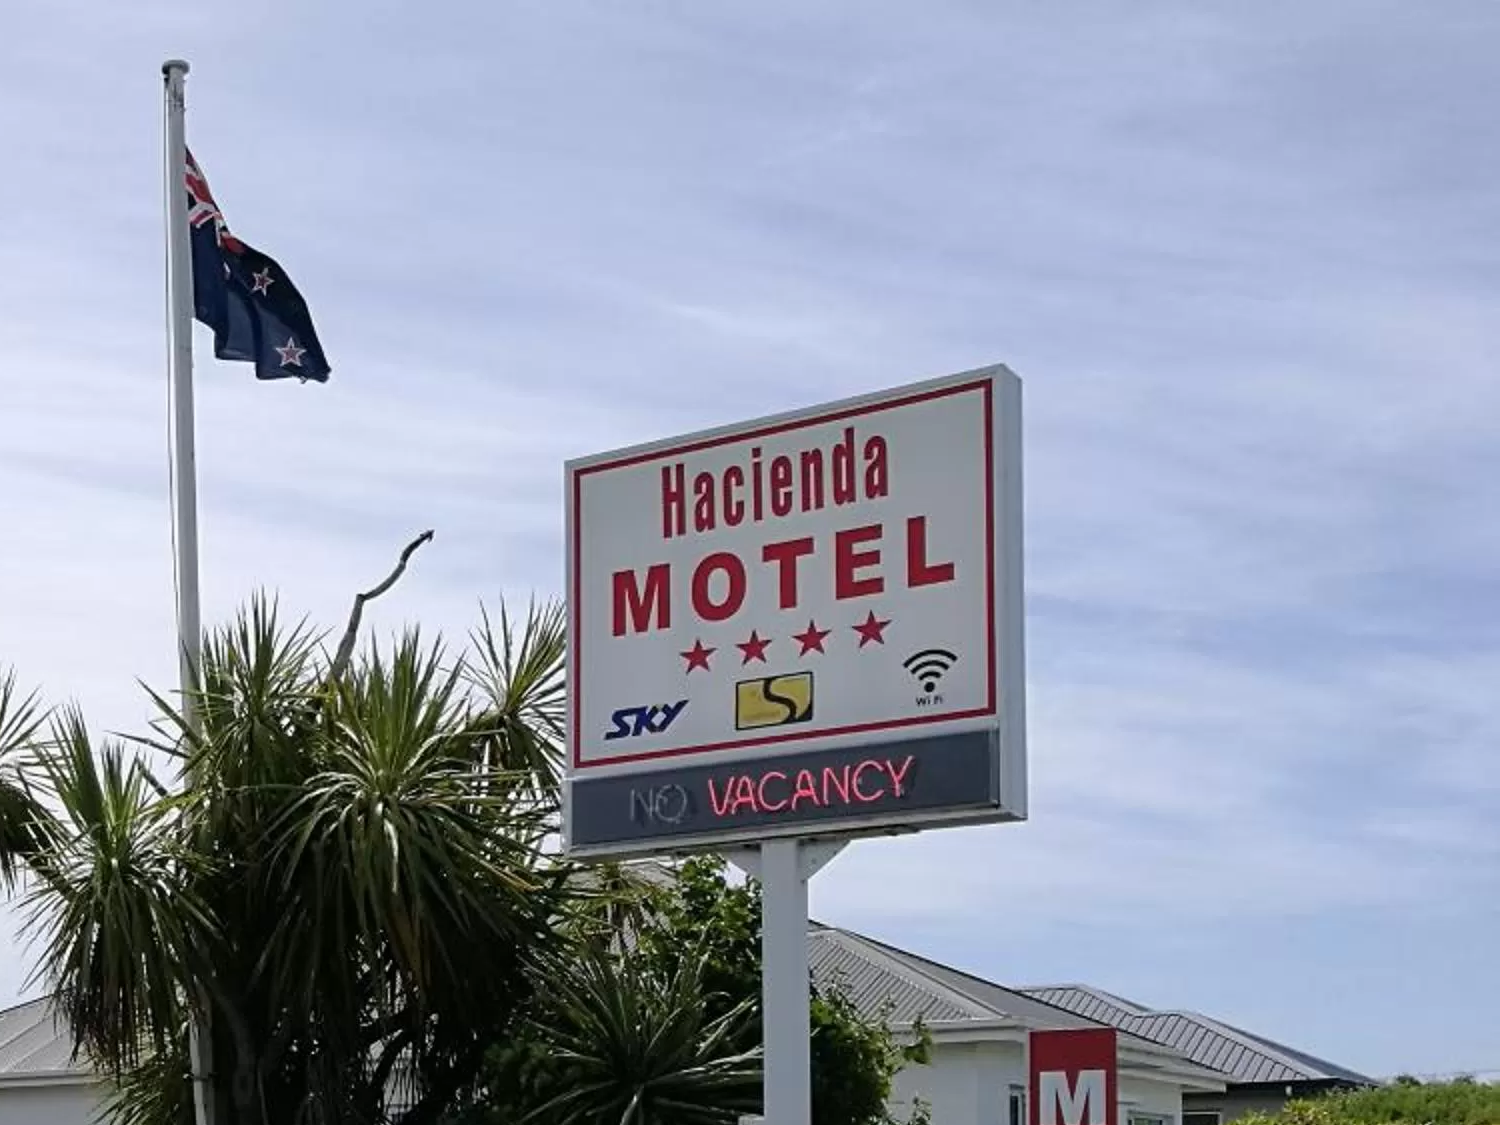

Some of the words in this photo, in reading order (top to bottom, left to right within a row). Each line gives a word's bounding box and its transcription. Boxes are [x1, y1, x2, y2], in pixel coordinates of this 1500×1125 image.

[661, 426, 889, 539] Hacienda
[611, 515, 955, 637] MOTEL
[604, 699, 690, 740] SKY
[629, 783, 689, 825] NO
[707, 755, 915, 816] VACANCY
